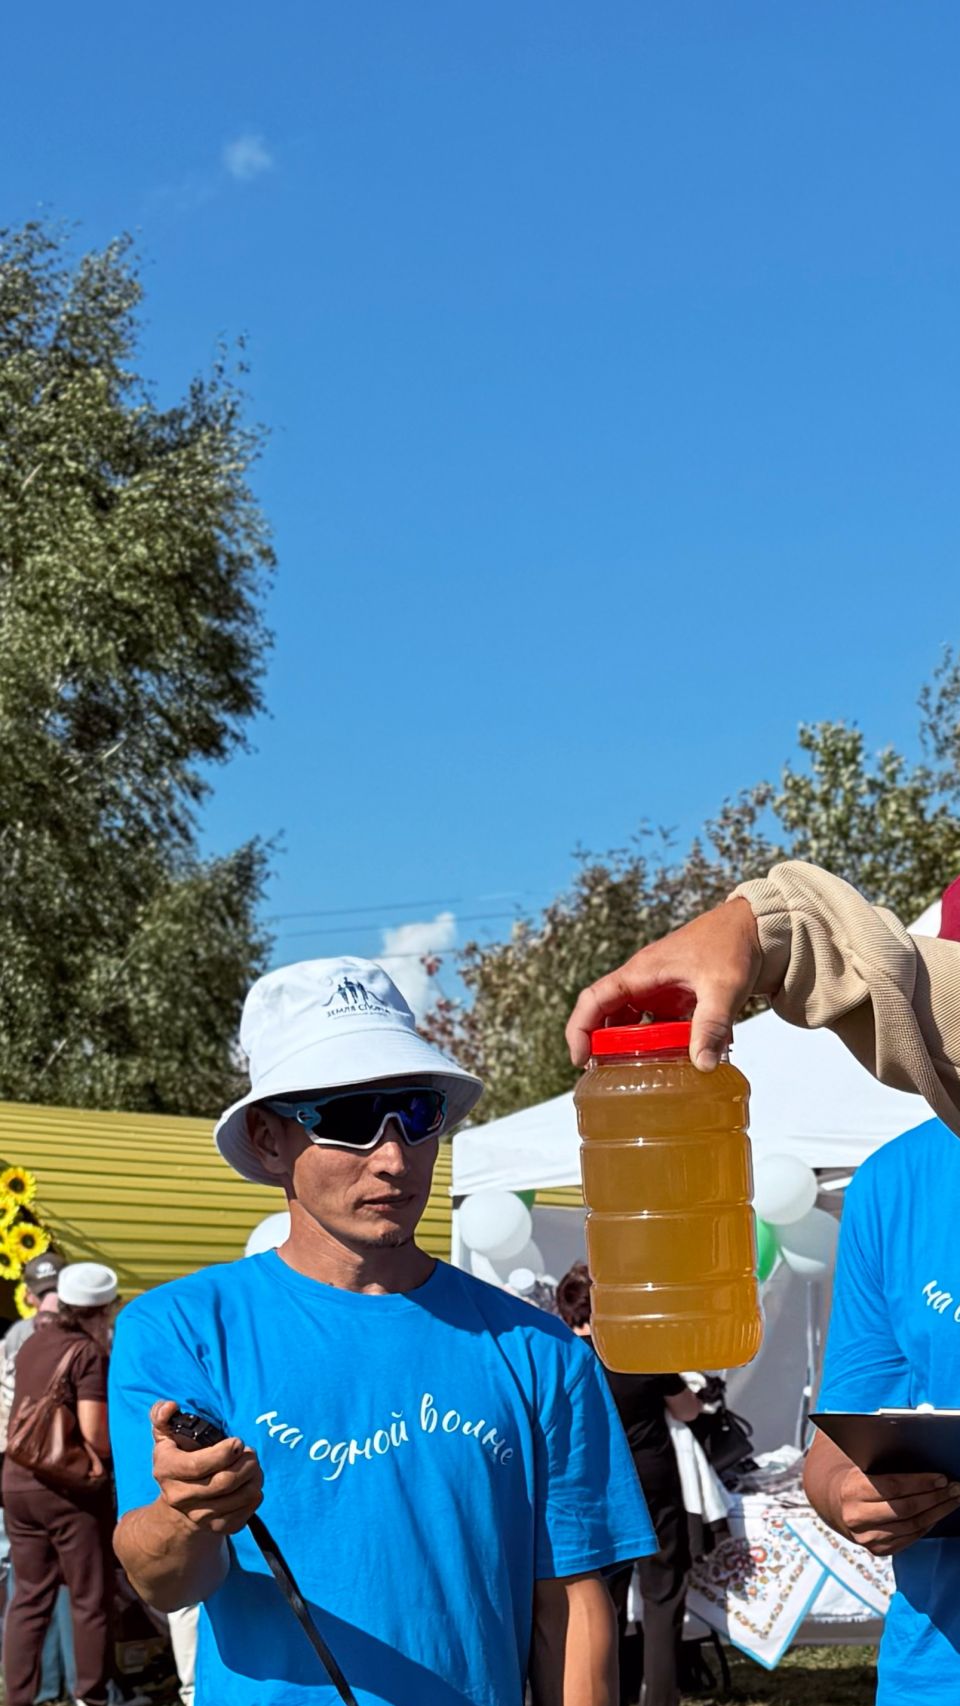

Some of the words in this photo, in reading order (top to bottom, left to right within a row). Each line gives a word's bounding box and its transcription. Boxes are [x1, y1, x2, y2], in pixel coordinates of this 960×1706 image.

[922, 1280, 953, 1315] на
[255, 1410, 303, 1449] на
[309, 1410, 409, 1481] одной
[420, 1392, 514, 1466] волне
